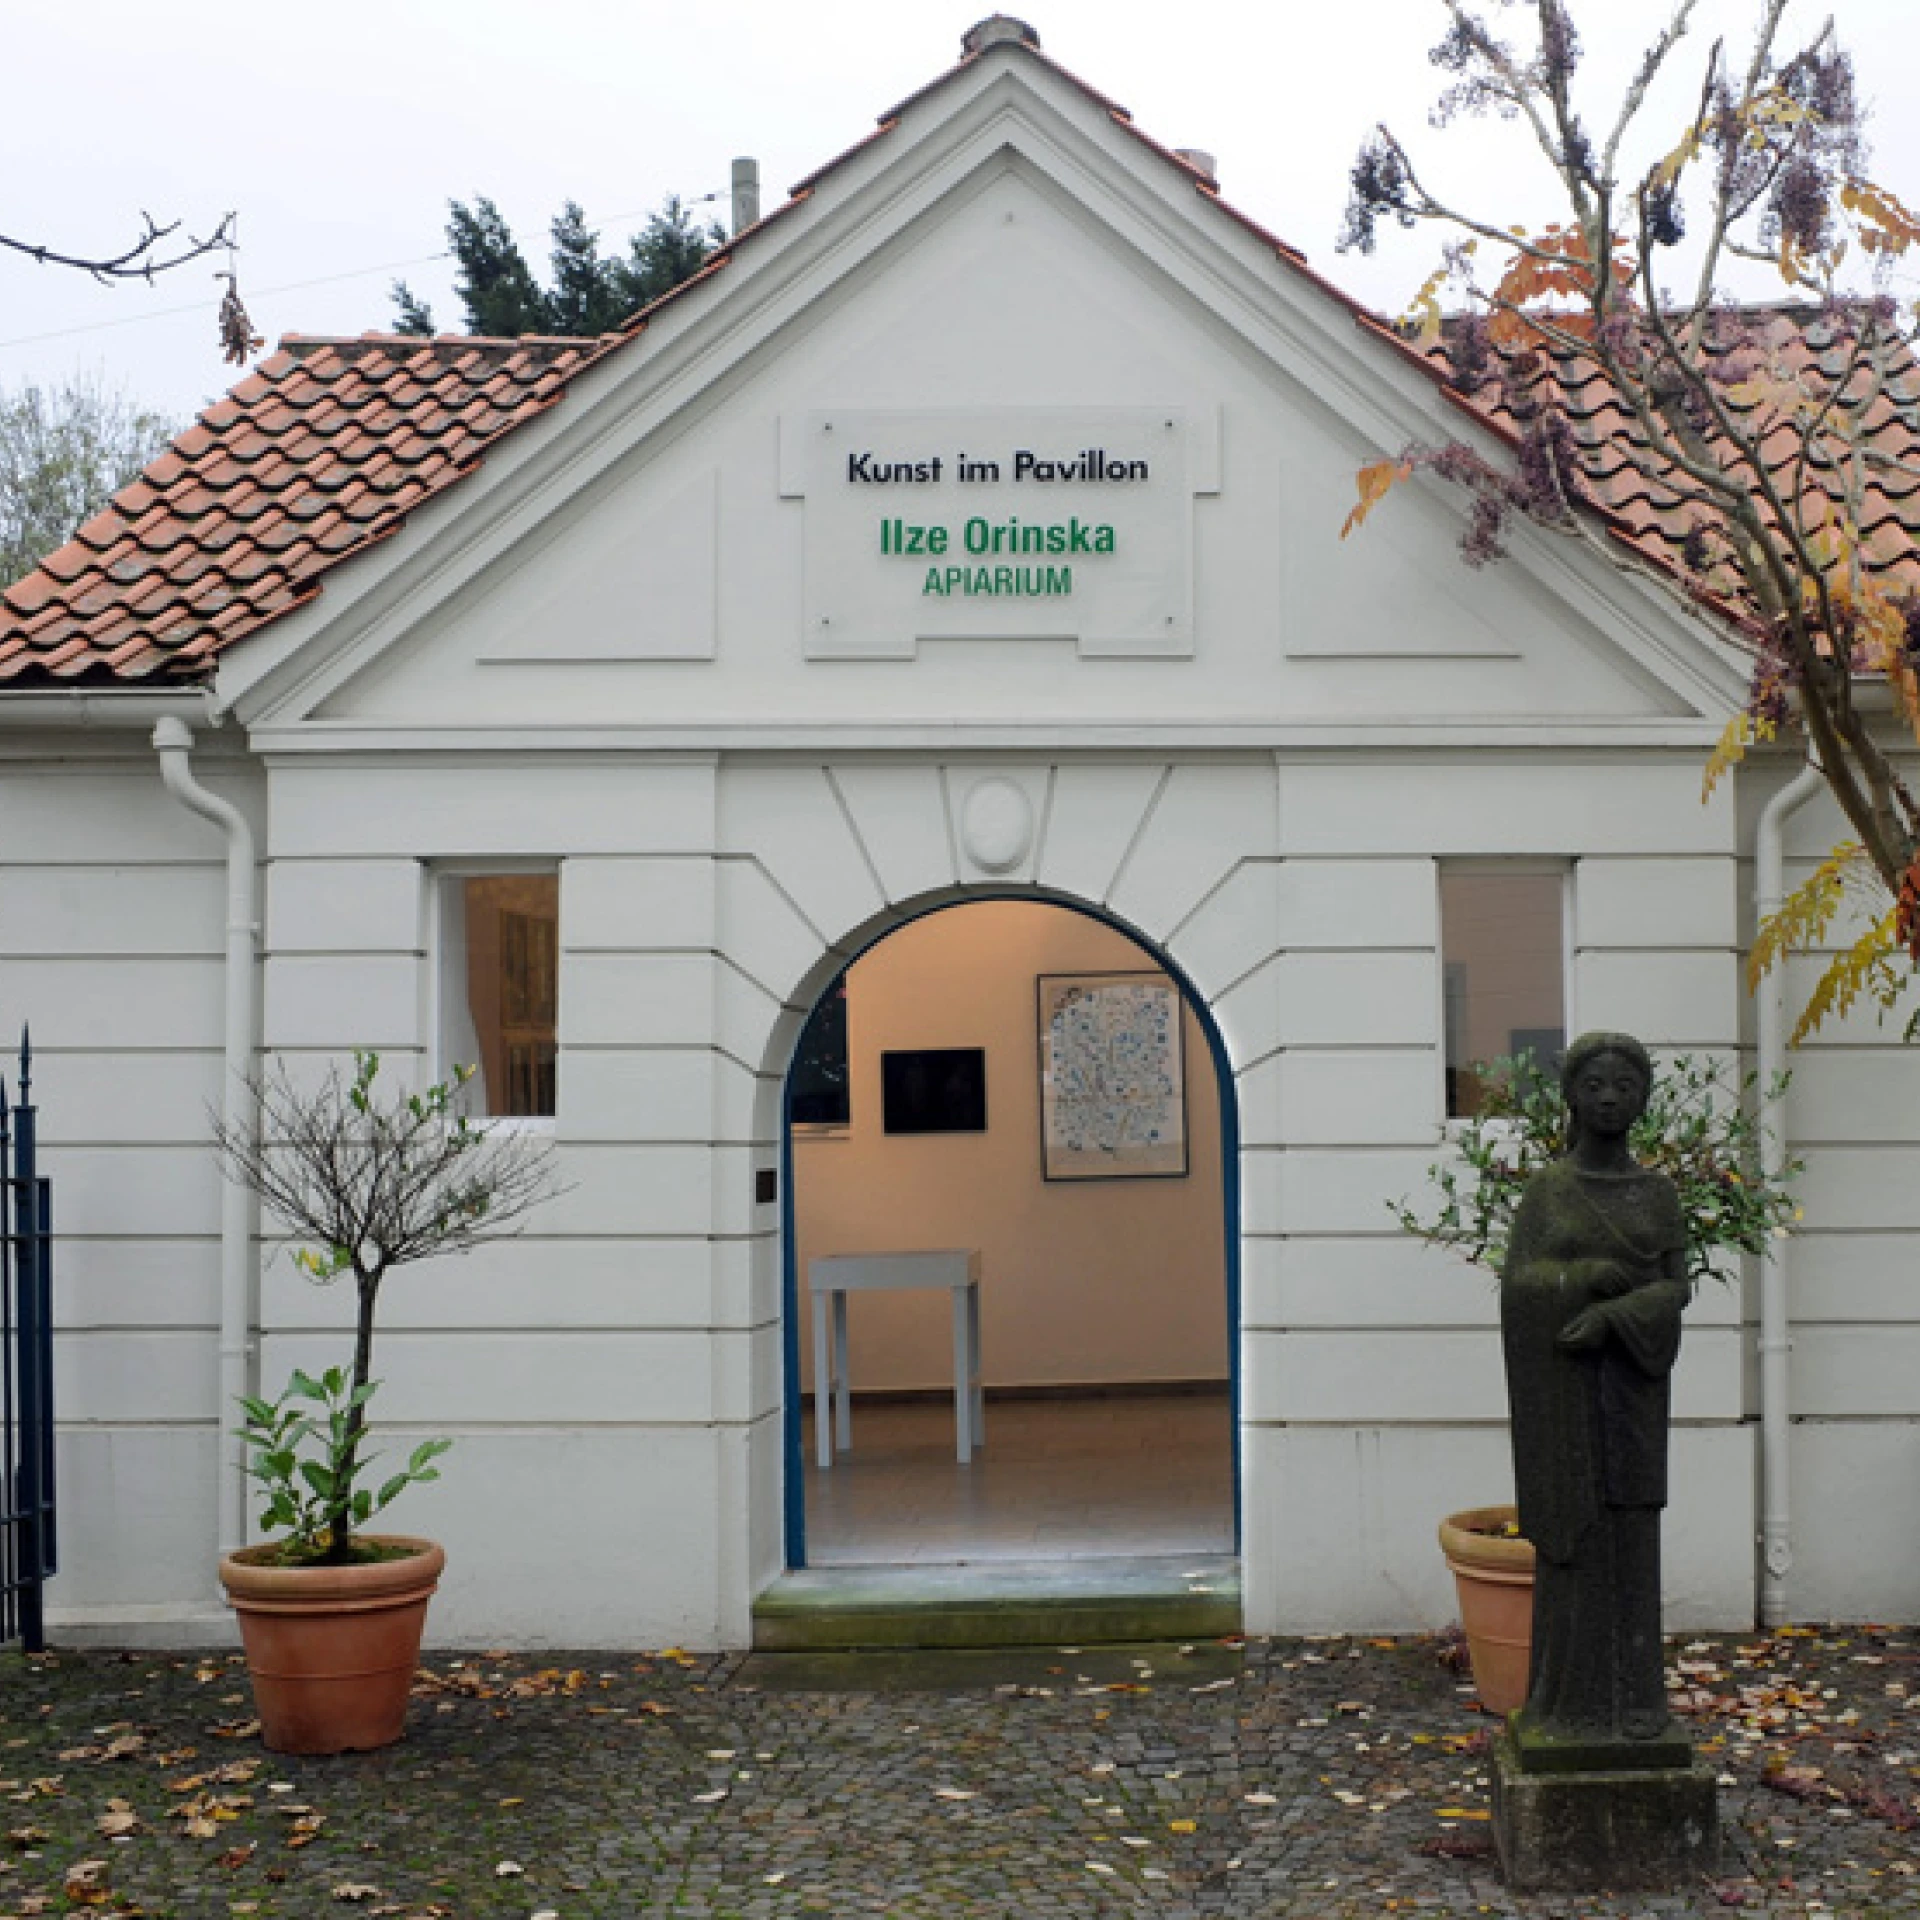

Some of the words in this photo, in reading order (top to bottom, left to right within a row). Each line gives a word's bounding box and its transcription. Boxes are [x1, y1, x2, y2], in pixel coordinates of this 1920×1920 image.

[848, 453, 943, 483] Kunst
[958, 453, 1000, 483] im
[1014, 450, 1149, 483] Pavillon
[880, 518, 948, 555] Ilze
[963, 516, 1116, 555] Orinska
[922, 565, 1072, 597] APIARIUM
